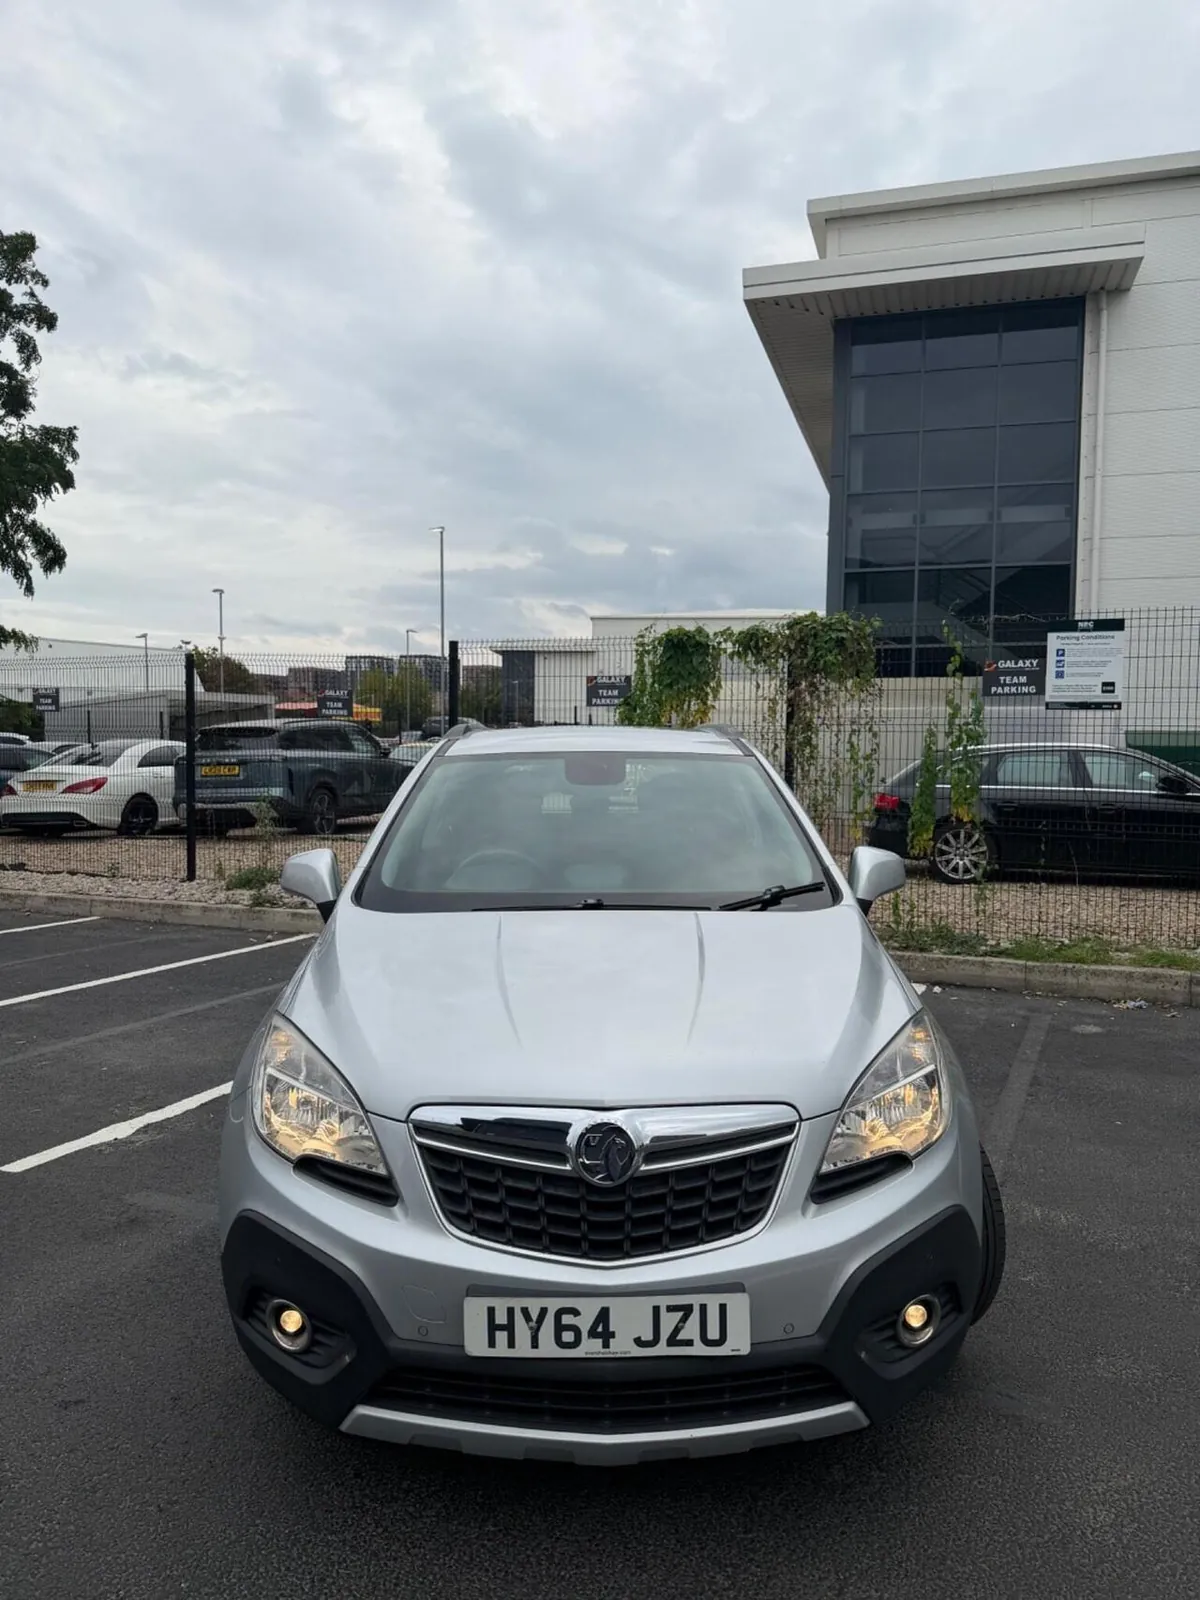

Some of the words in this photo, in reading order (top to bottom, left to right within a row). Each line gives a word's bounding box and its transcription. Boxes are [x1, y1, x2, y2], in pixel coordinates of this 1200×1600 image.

[998, 659, 1039, 668] GALAXY
[597, 676, 626, 684] GALAXY
[999, 676, 1027, 684] TEAM
[991, 686, 1036, 694] PARKING
[486, 1305, 616, 1350] HY64
[633, 1302, 728, 1349] JZU
